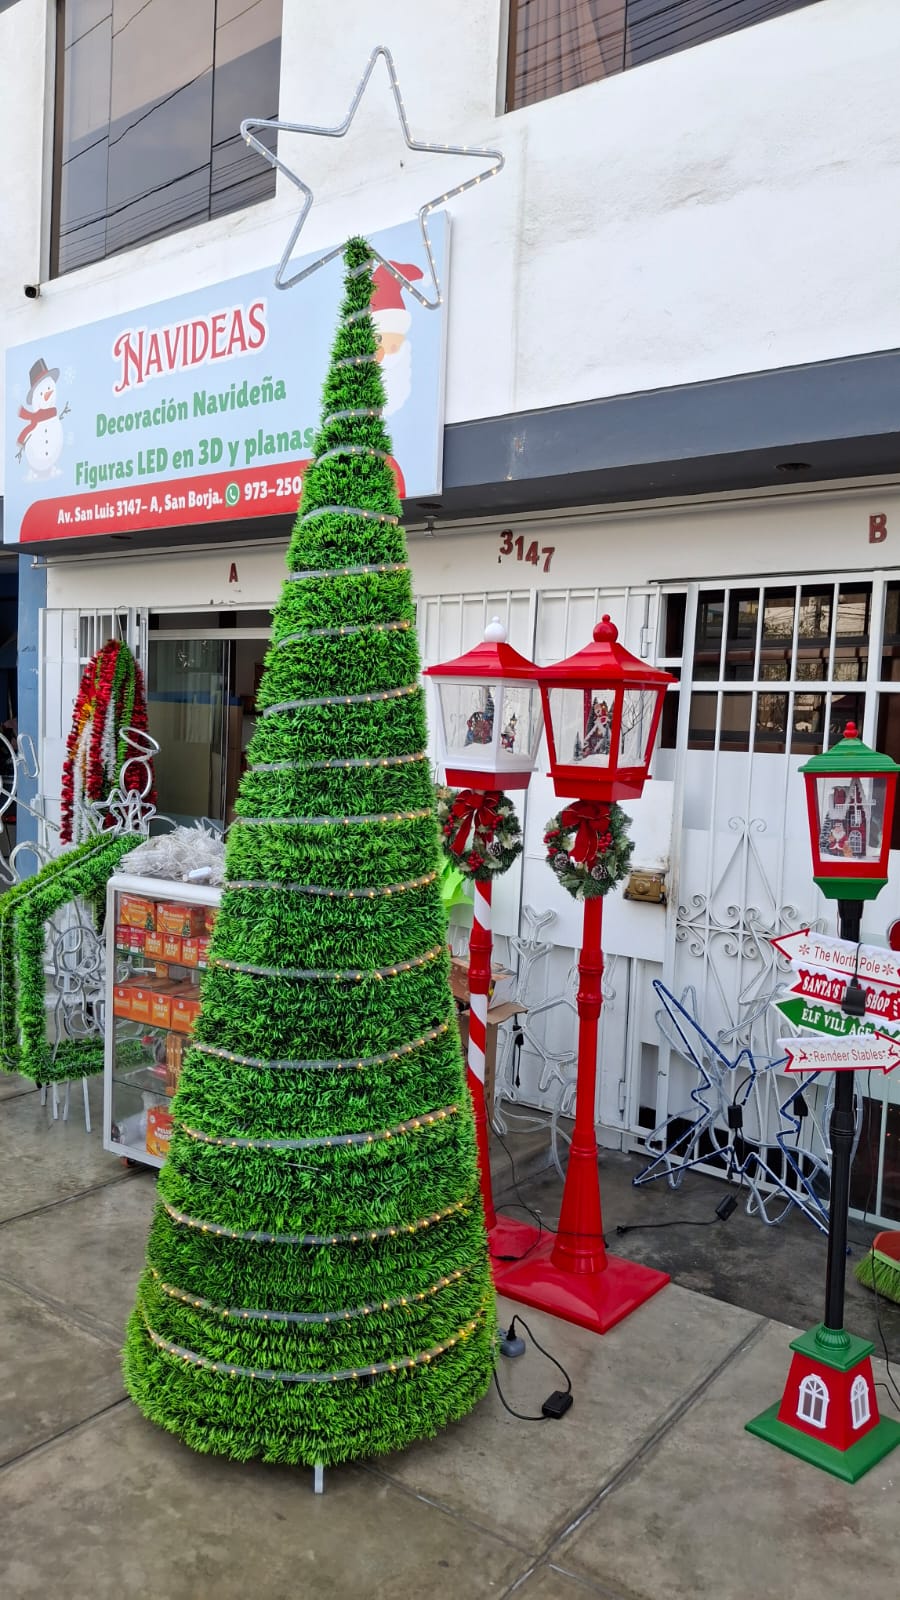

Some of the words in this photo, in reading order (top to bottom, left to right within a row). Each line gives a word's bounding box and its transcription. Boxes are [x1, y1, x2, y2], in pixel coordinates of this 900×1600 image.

[114, 303, 266, 392] NAVIDEAS
[96, 398, 188, 437] Decoración
[193, 376, 286, 418] Navideña
[75, 459, 133, 489] Figuras
[137, 448, 168, 476] LED
[172, 450, 193, 469] en
[199, 437, 223, 466] 3D
[228, 440, 240, 467] y
[245, 427, 314, 464] planas
[57, 509, 73, 524] Av.
[75, 507, 92, 522] San
[95, 503, 114, 520] Luis
[150, 496, 162, 514] A,
[164, 494, 186, 511] San
[188, 488, 223, 510] Borja.
[869, 513, 887, 544] B
[499, 529, 555, 573] 3147
[229, 562, 238, 583] A
[814, 946, 831, 961] The
[832, 952, 858, 967] North
[860, 957, 880, 973] Pole
[802, 975, 839, 998] SANTA'S
[802, 1008, 822, 1024] ELF
[814, 1050, 850, 1062] Reindeer
[851, 1049, 883, 1061] Stables
